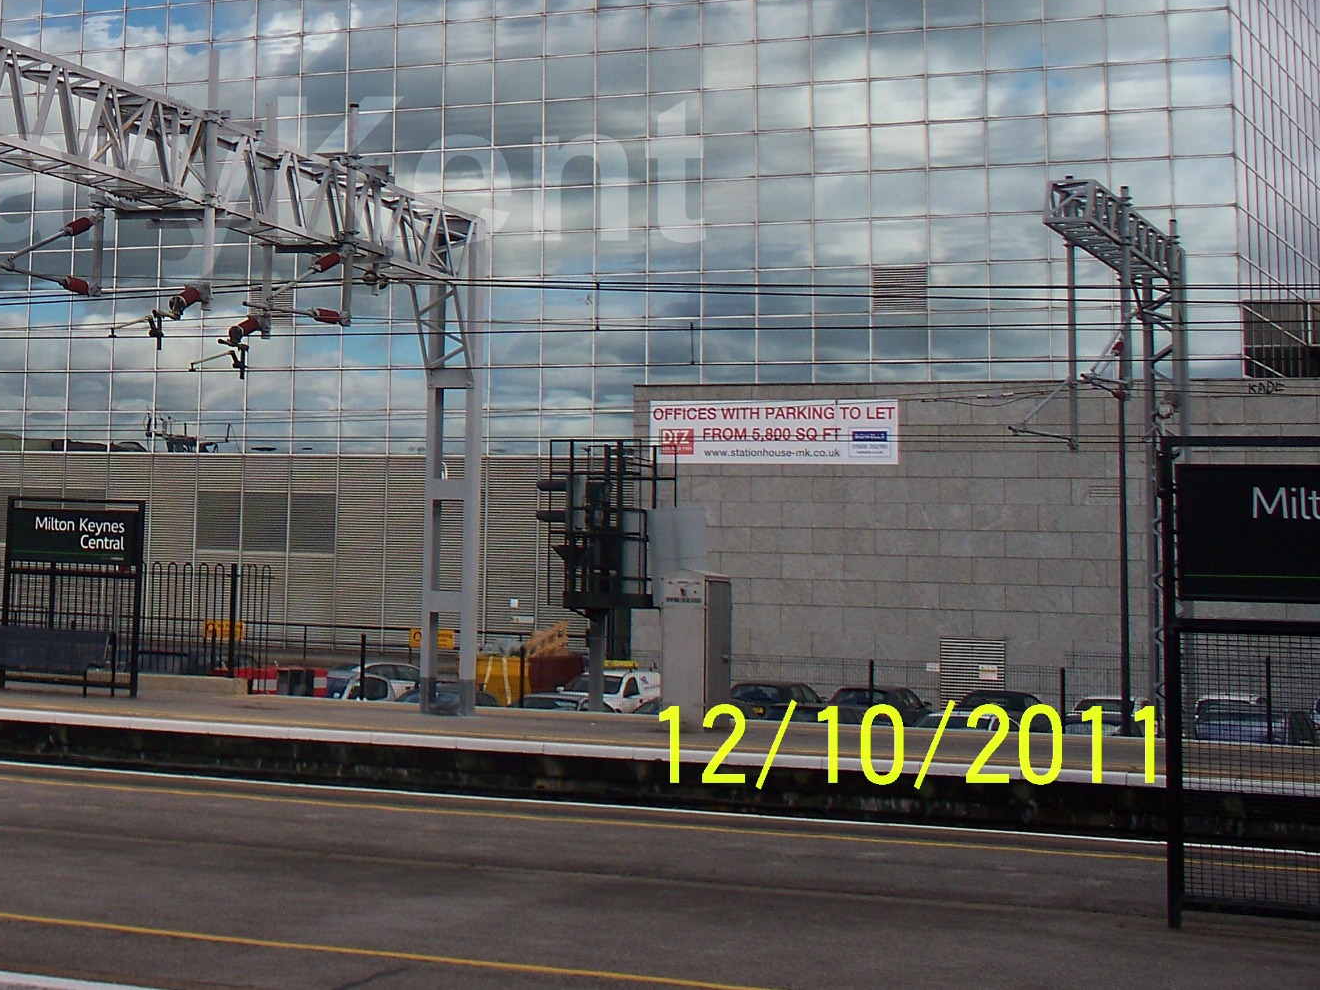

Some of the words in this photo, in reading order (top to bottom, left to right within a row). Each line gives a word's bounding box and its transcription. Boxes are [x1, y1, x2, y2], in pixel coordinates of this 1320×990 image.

[653, 407, 717, 421] OFFICES
[721, 407, 760, 420] WITH
[765, 406, 835, 420] PARKING
[840, 406, 861, 420] TO
[866, 406, 895, 420] LET
[662, 430, 690, 444] DTZ
[702, 428, 747, 441] FROM
[751, 427, 791, 442] 5,800
[795, 427, 817, 441] SQ
[822, 427, 841, 441] FT
[703, 448, 840, 457] www.stationhouse-mk.co.uk
[35, 516, 75, 531] Milton
[79, 517, 125, 536] Keynes
[80, 534, 125, 551] Central
